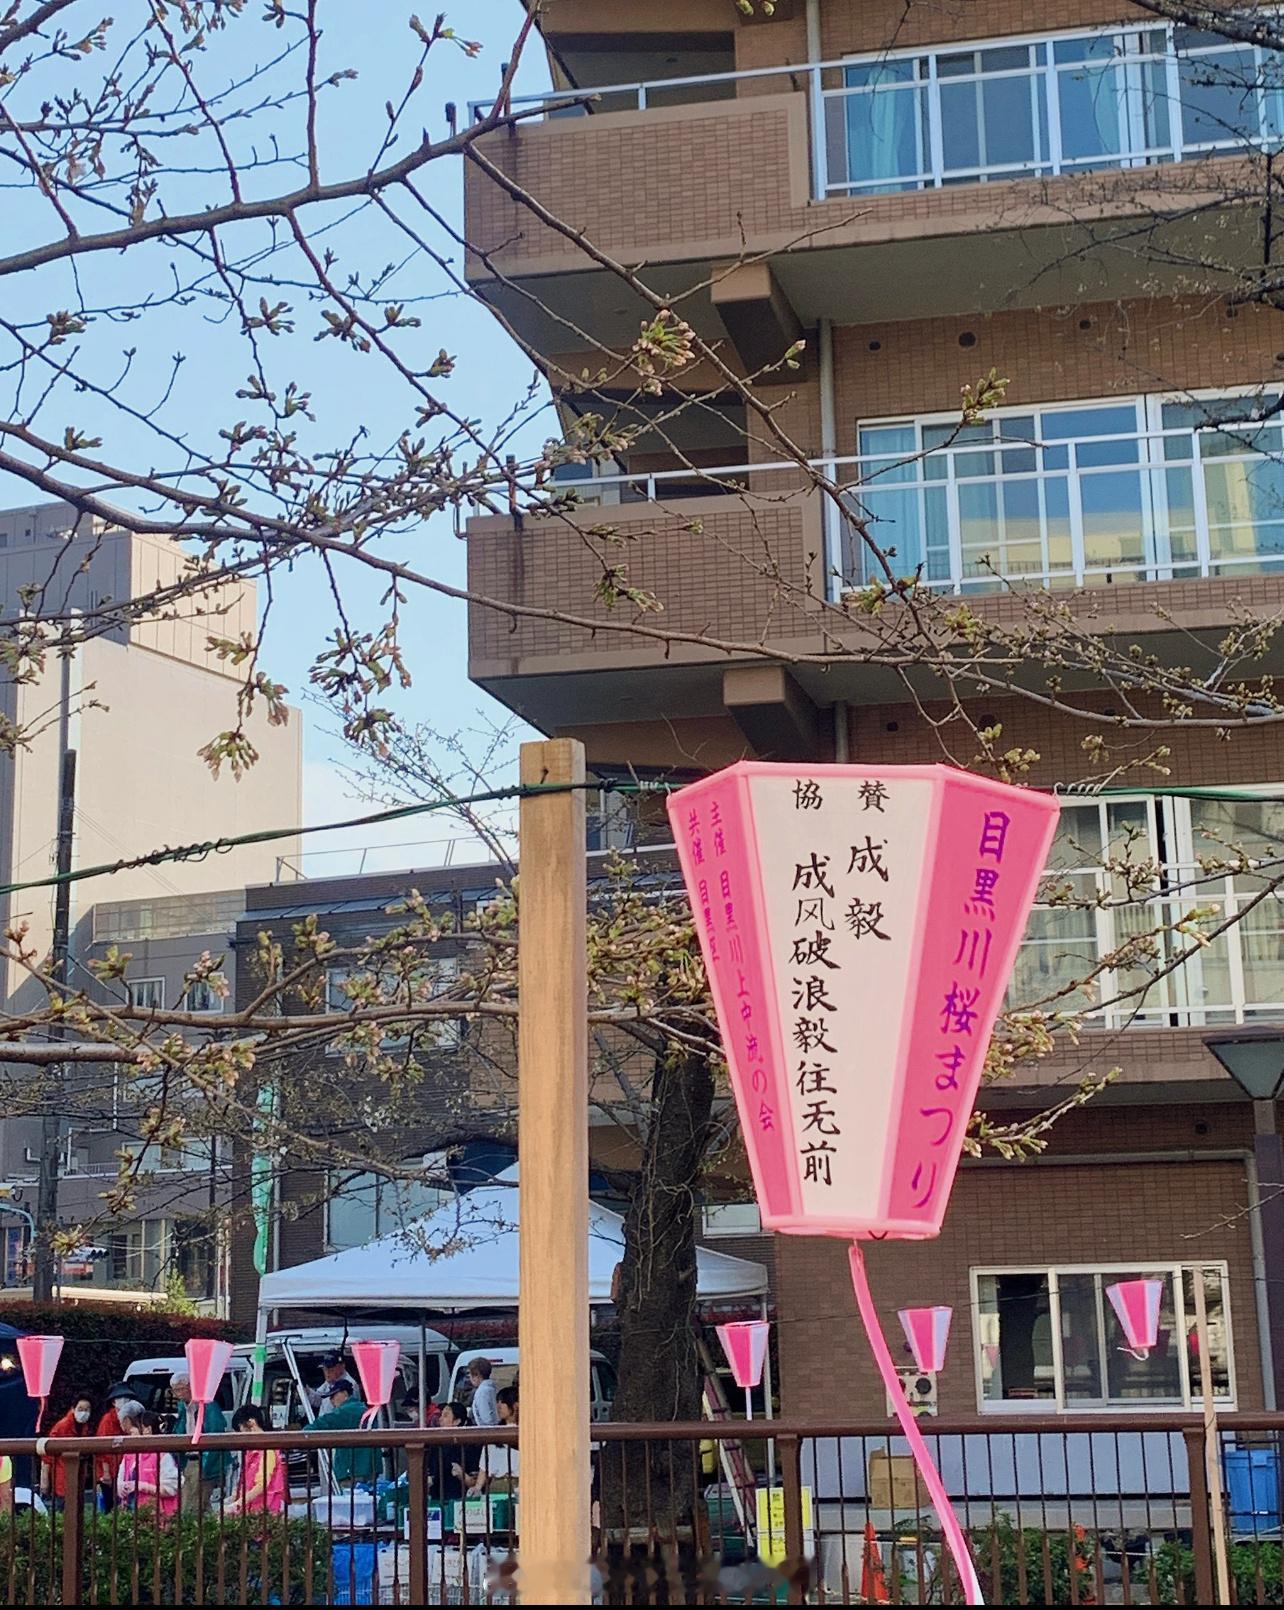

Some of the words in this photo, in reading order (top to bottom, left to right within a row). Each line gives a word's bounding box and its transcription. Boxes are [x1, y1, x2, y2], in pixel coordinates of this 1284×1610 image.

[845, 835, 892, 941] 成毅
[911, 810, 1011, 1209] 目黒川桜まつり
